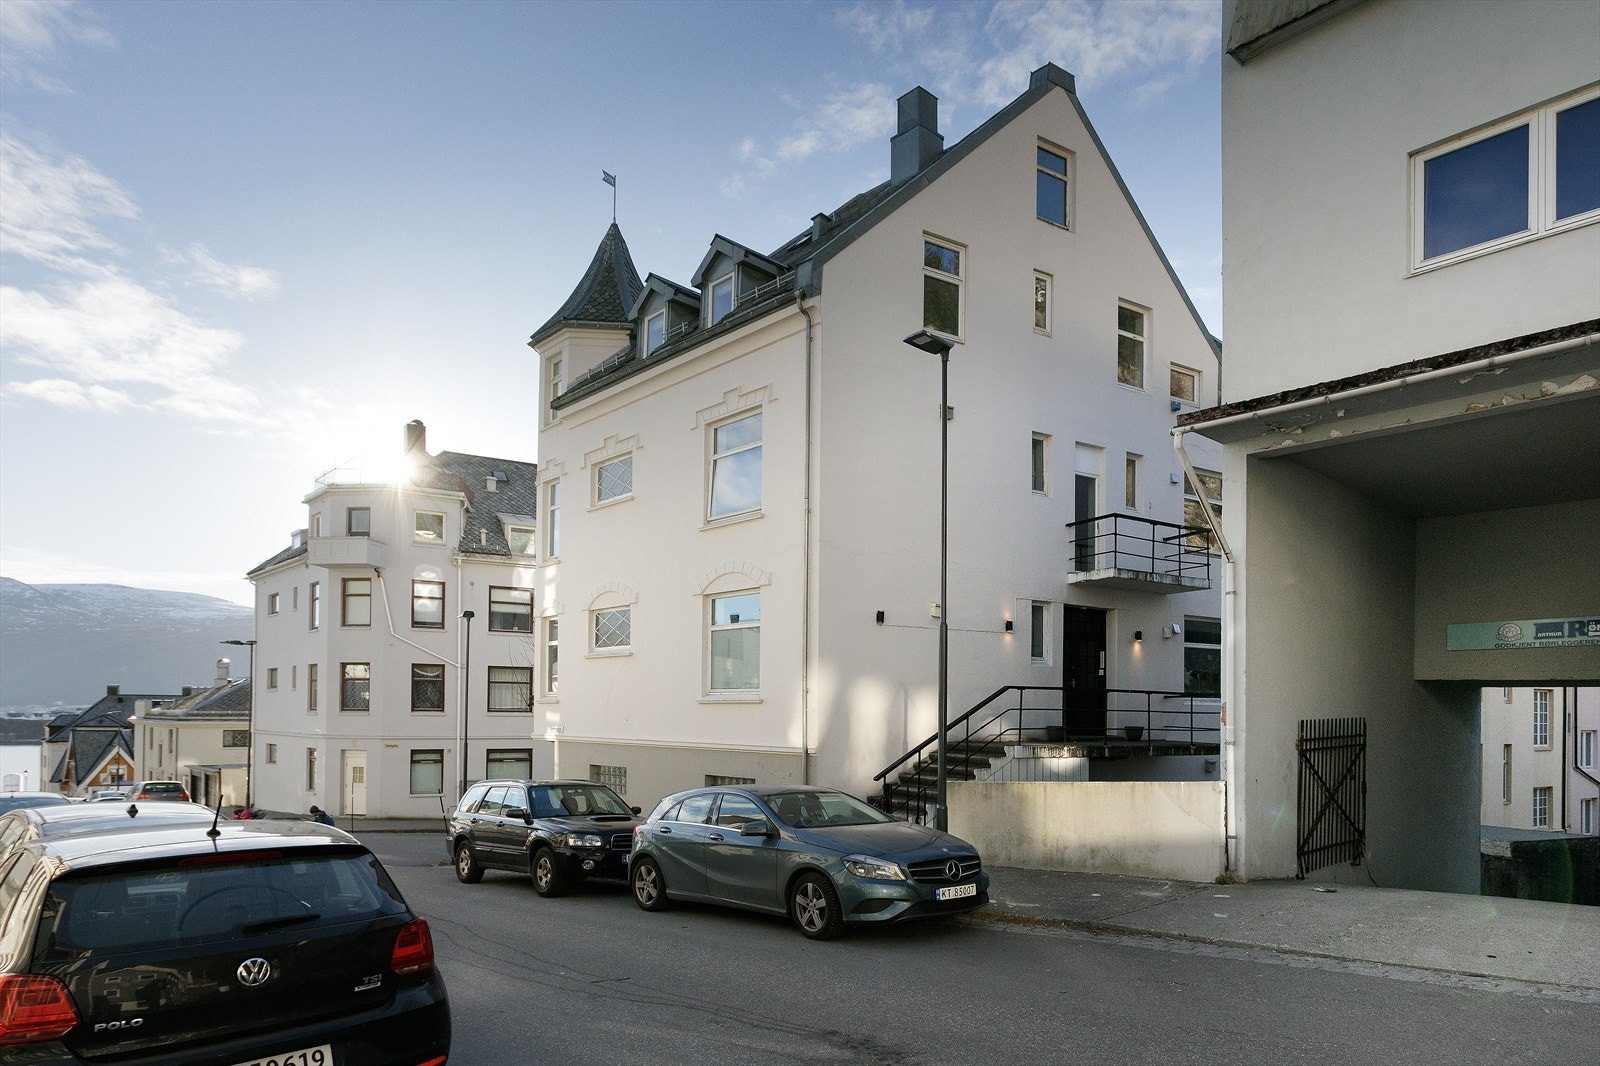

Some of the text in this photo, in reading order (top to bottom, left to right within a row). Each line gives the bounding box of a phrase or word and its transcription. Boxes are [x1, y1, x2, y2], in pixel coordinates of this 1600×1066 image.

[1494, 641, 1537, 649] GODKJENT
[941, 889, 951, 899] KT
[94, 1018, 144, 1032] POLO
